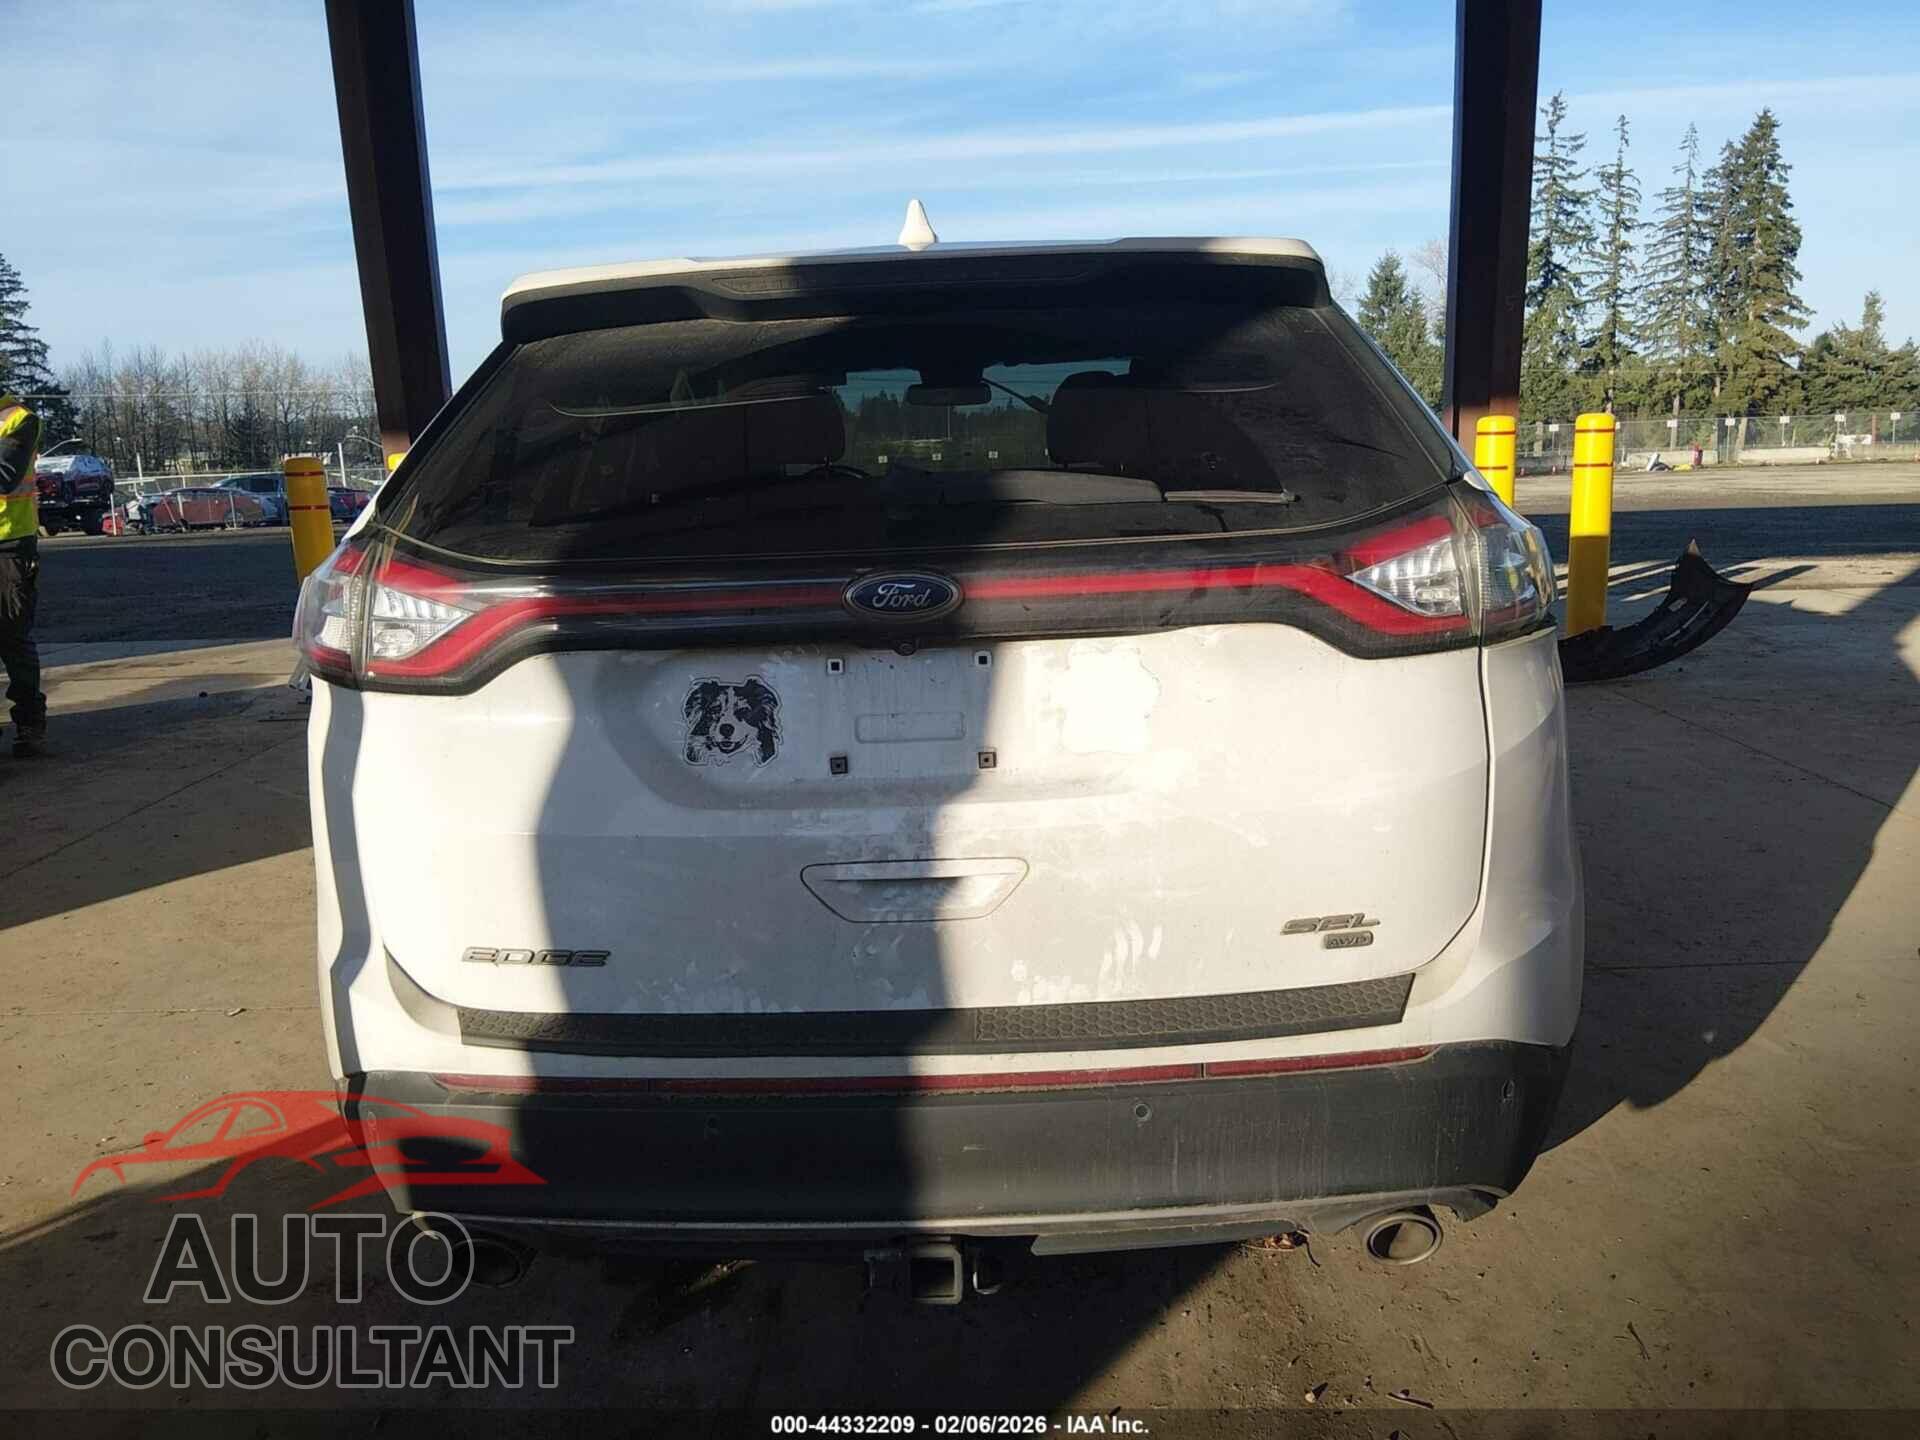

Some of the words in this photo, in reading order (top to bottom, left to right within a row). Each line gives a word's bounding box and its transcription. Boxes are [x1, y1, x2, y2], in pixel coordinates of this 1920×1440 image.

[872, 583, 931, 608] Ford
[1280, 912, 1381, 935] SEL
[461, 946, 612, 967] EDGE
